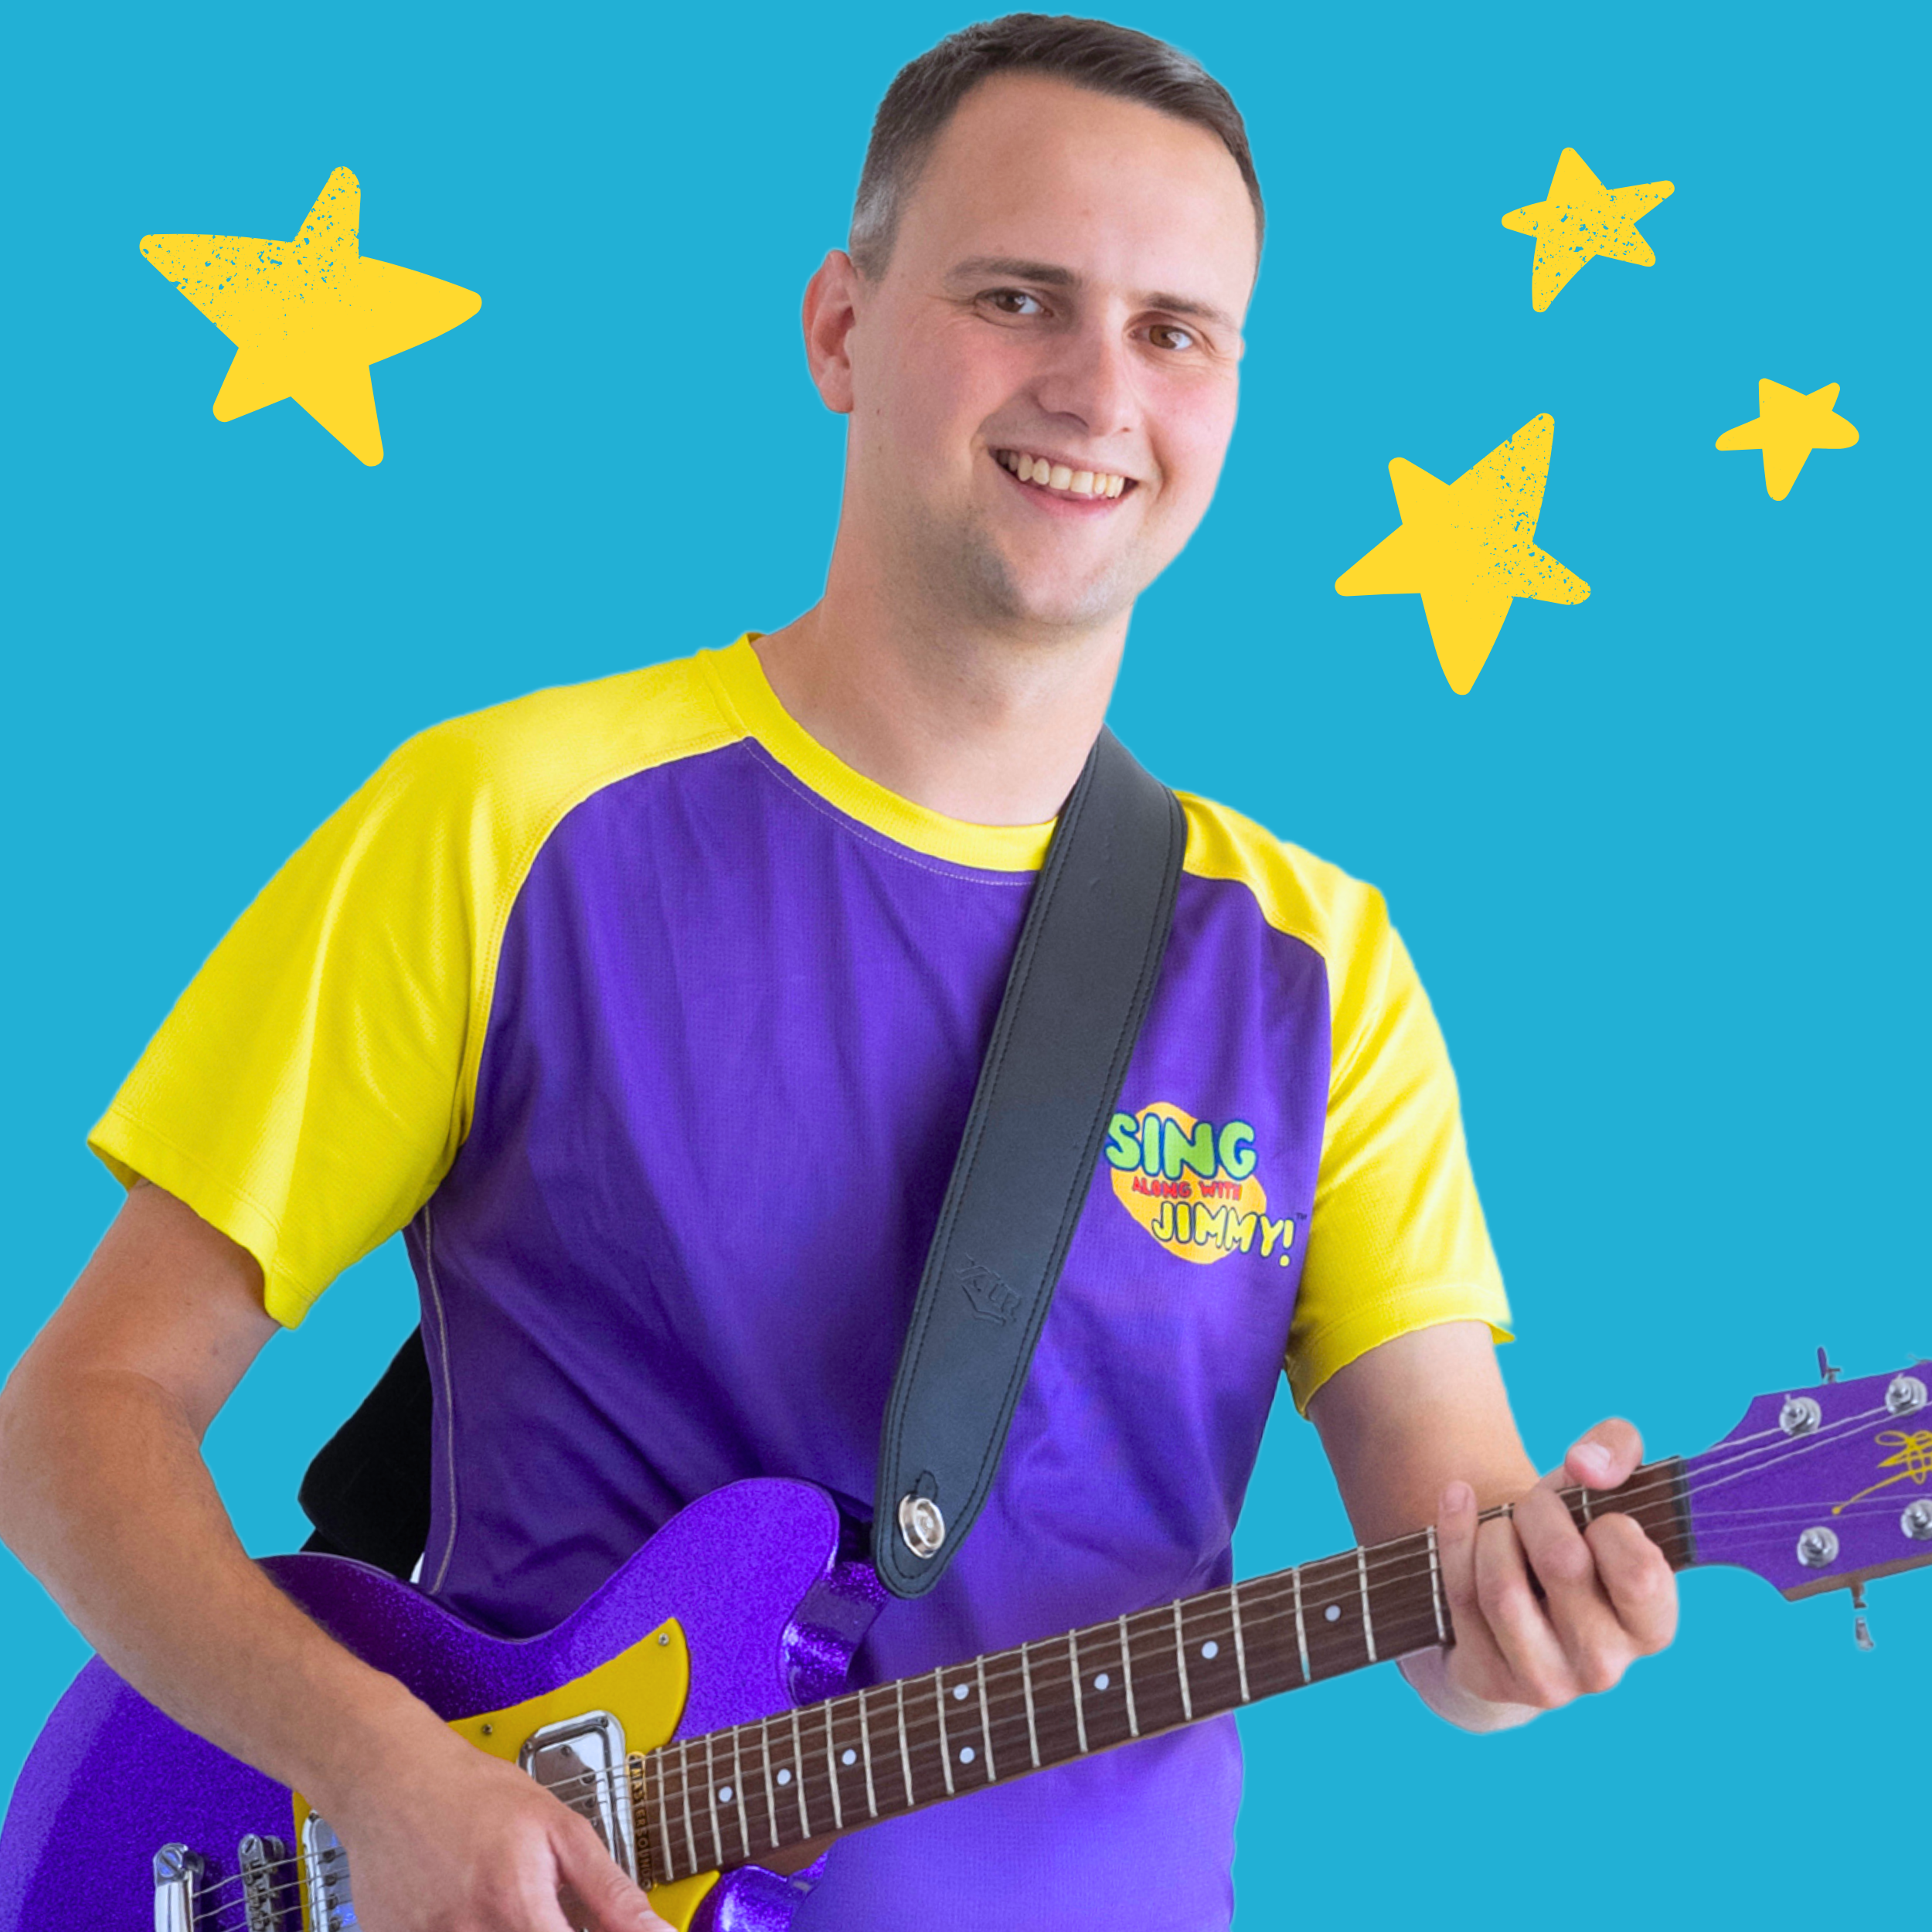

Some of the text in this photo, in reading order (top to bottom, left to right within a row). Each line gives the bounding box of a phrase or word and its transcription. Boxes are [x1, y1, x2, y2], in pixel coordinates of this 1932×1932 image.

[1104, 1112, 1258, 1180] SING
[1132, 1176, 1243, 1201] ALONG WITH
[1151, 1201, 1295, 1267] JIMMY!
